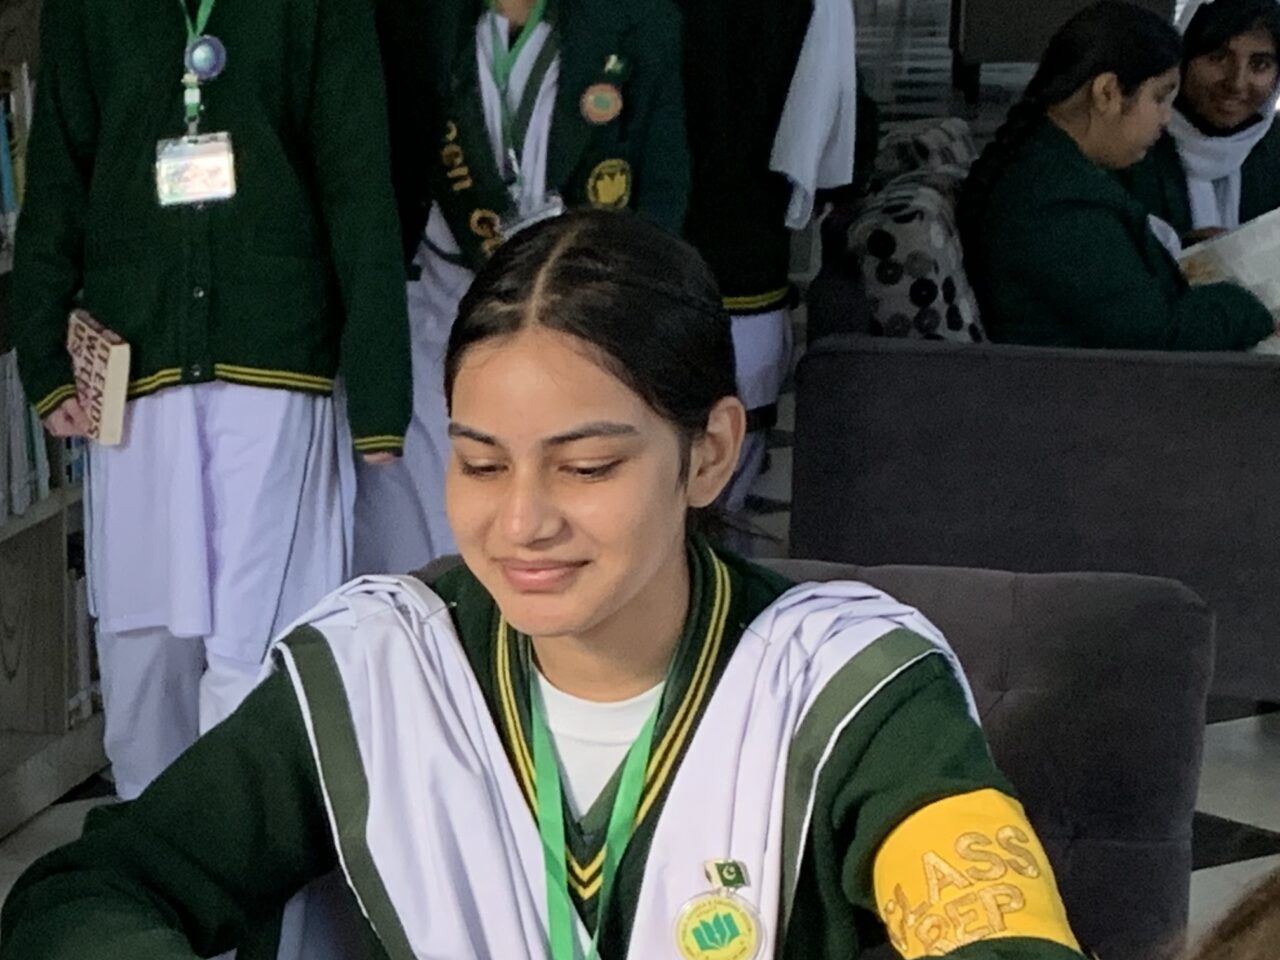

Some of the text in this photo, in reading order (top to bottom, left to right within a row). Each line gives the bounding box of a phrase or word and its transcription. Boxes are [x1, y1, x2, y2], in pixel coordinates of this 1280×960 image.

[71, 322, 86, 358] US
[87, 343, 111, 440] IT ENDS
[915, 882, 1027, 957] REP
